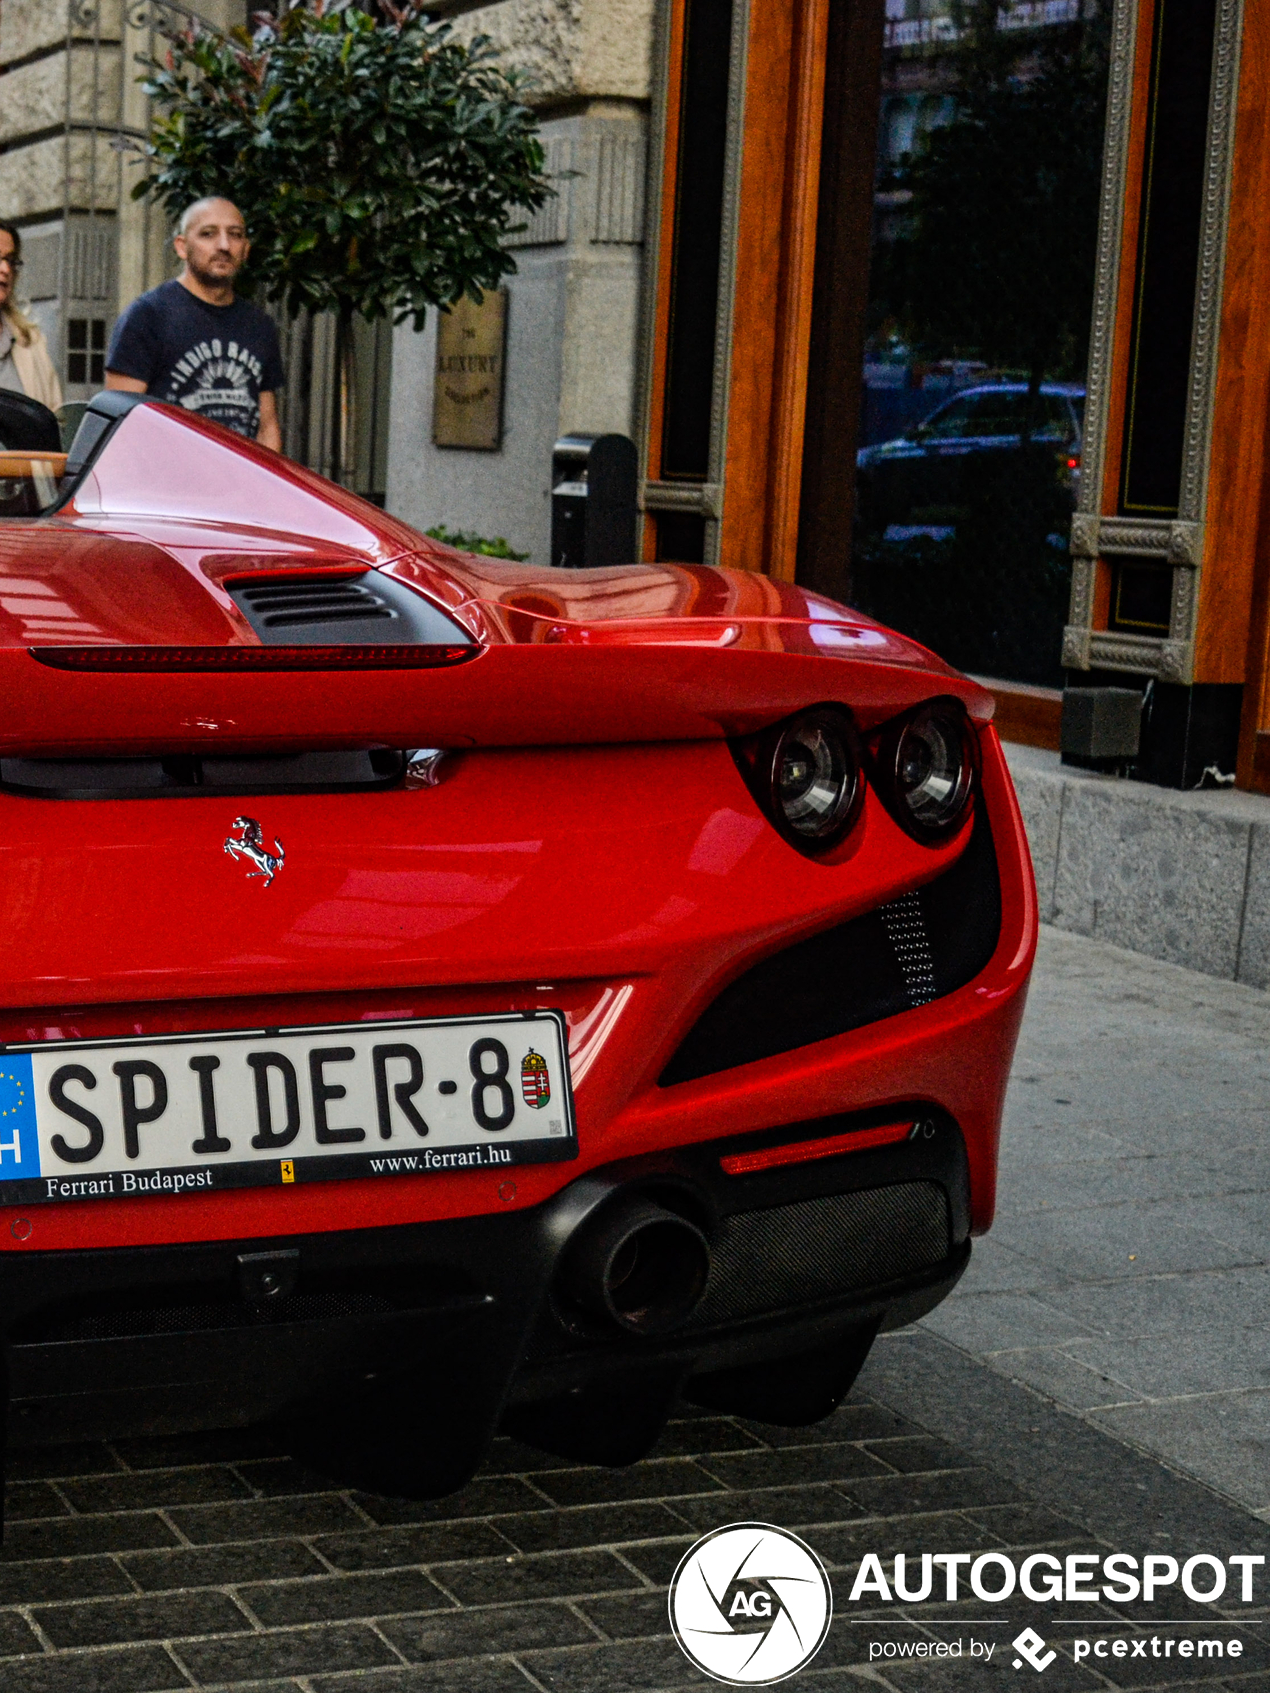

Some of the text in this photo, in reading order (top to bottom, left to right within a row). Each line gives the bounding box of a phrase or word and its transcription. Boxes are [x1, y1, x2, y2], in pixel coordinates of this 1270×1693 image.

[171, 338, 223, 384] INDIGO
[49, 1037, 515, 1164] SPIDER-8
[370, 1145, 512, 1173] www.ferrari.hu
[46, 1168, 214, 1198] Ferrari Budapest
